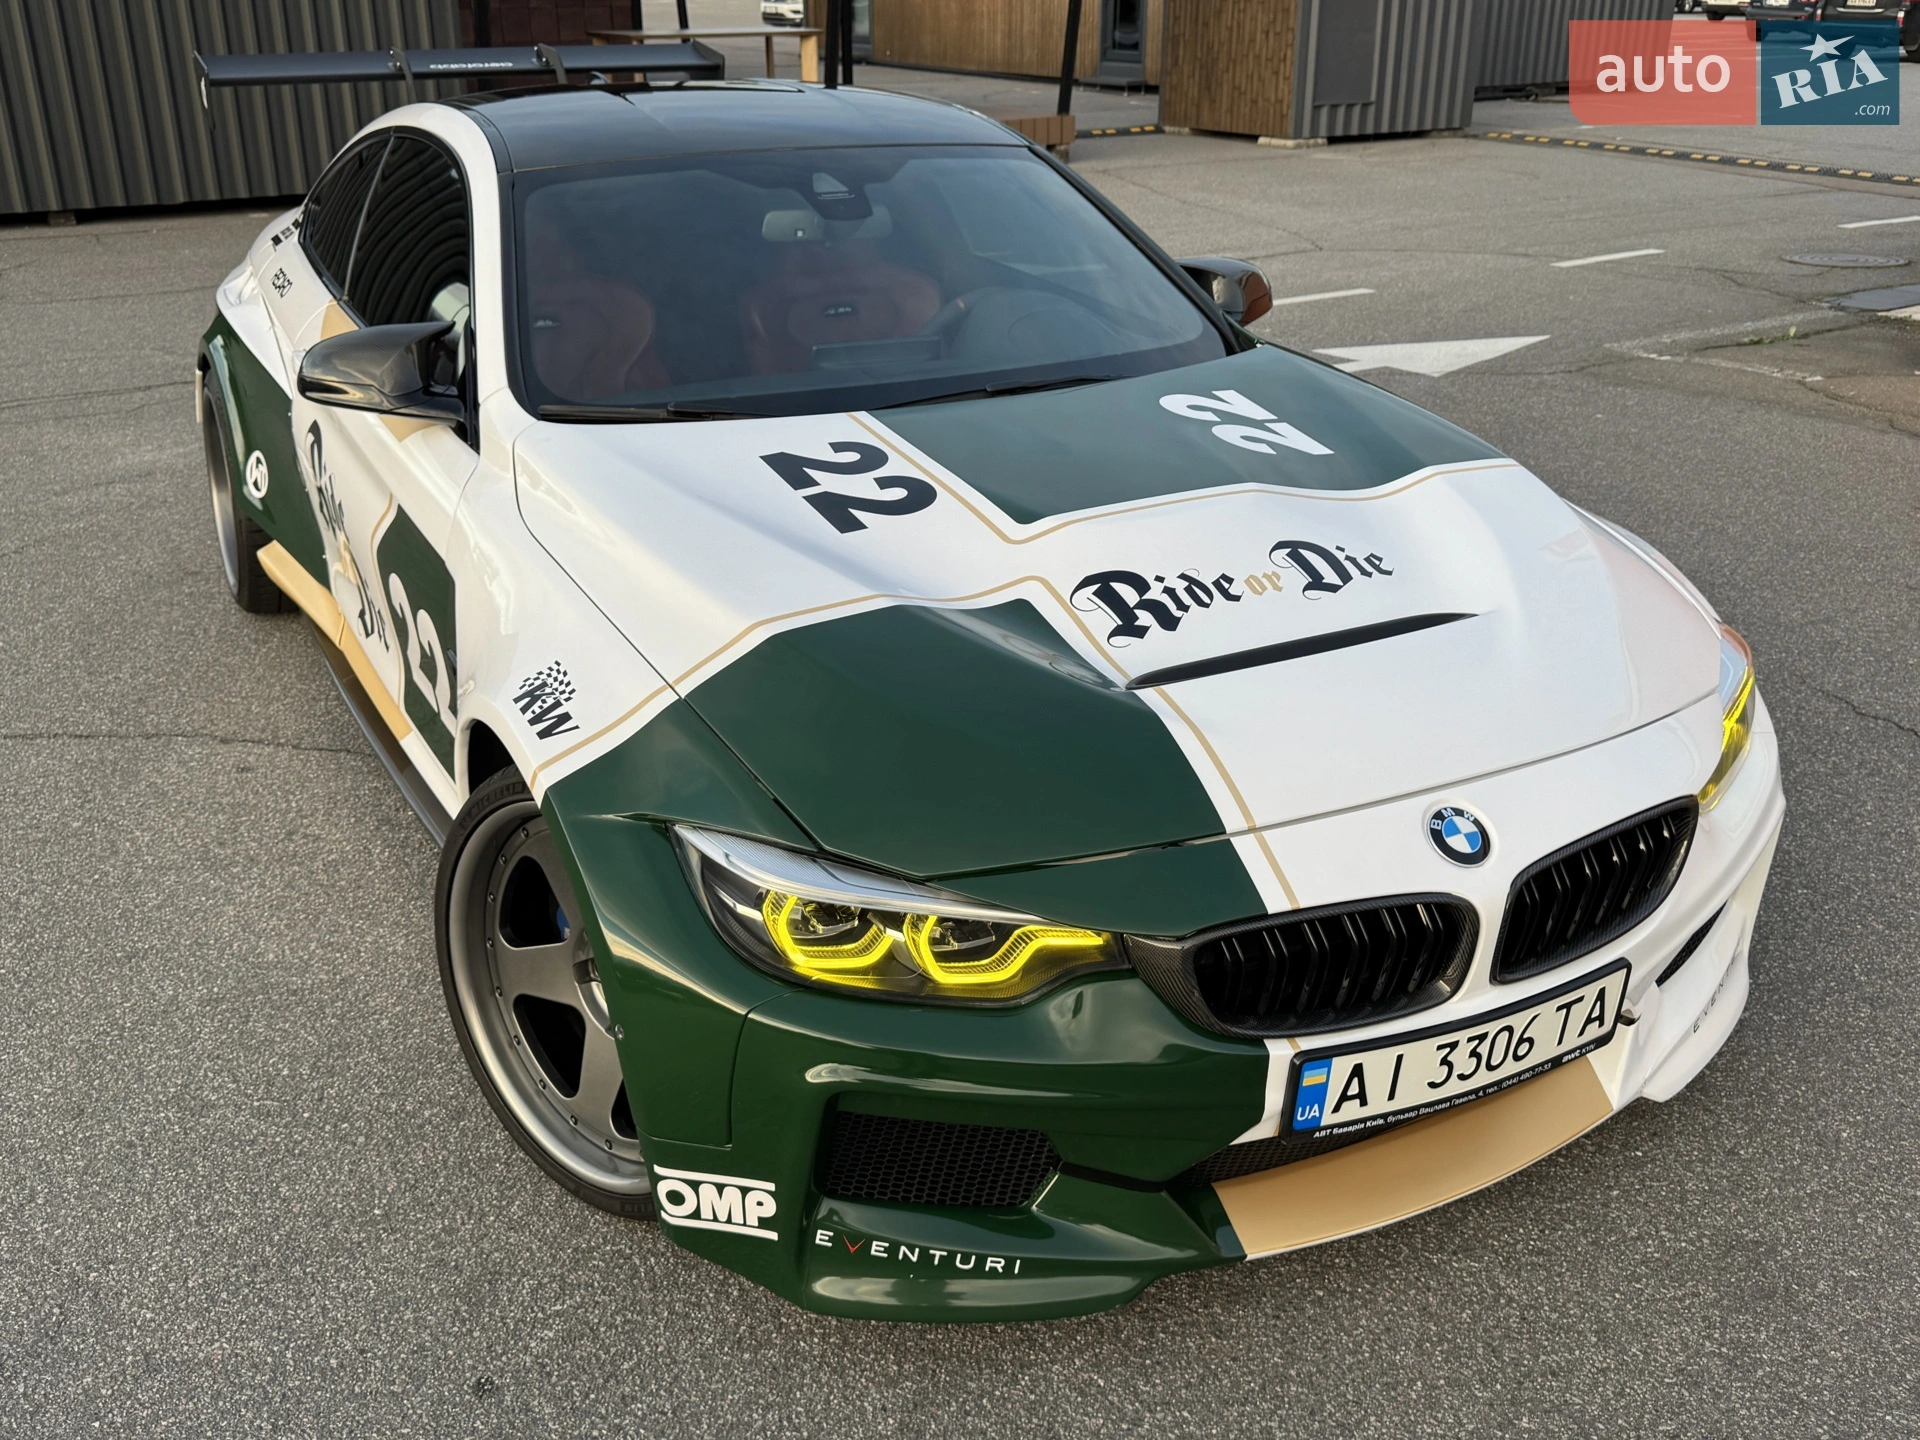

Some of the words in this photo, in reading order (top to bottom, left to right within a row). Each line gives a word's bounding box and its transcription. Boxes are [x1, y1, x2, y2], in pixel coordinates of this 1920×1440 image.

[1159, 389, 1335, 456] 22
[758, 441, 938, 534] 22
[1070, 568, 1244, 648] Ride
[1244, 570, 1283, 596] or
[1268, 540, 1394, 600] Die
[512, 680, 580, 741] KW
[1430, 807, 1475, 830] BMW
[1427, 1012, 1540, 1090] 3306
[1556, 986, 1606, 1047] TA
[1297, 1103, 1320, 1121] UA
[656, 1178, 777, 1227] OMP
[814, 1229, 1021, 1275] EVENTURI
